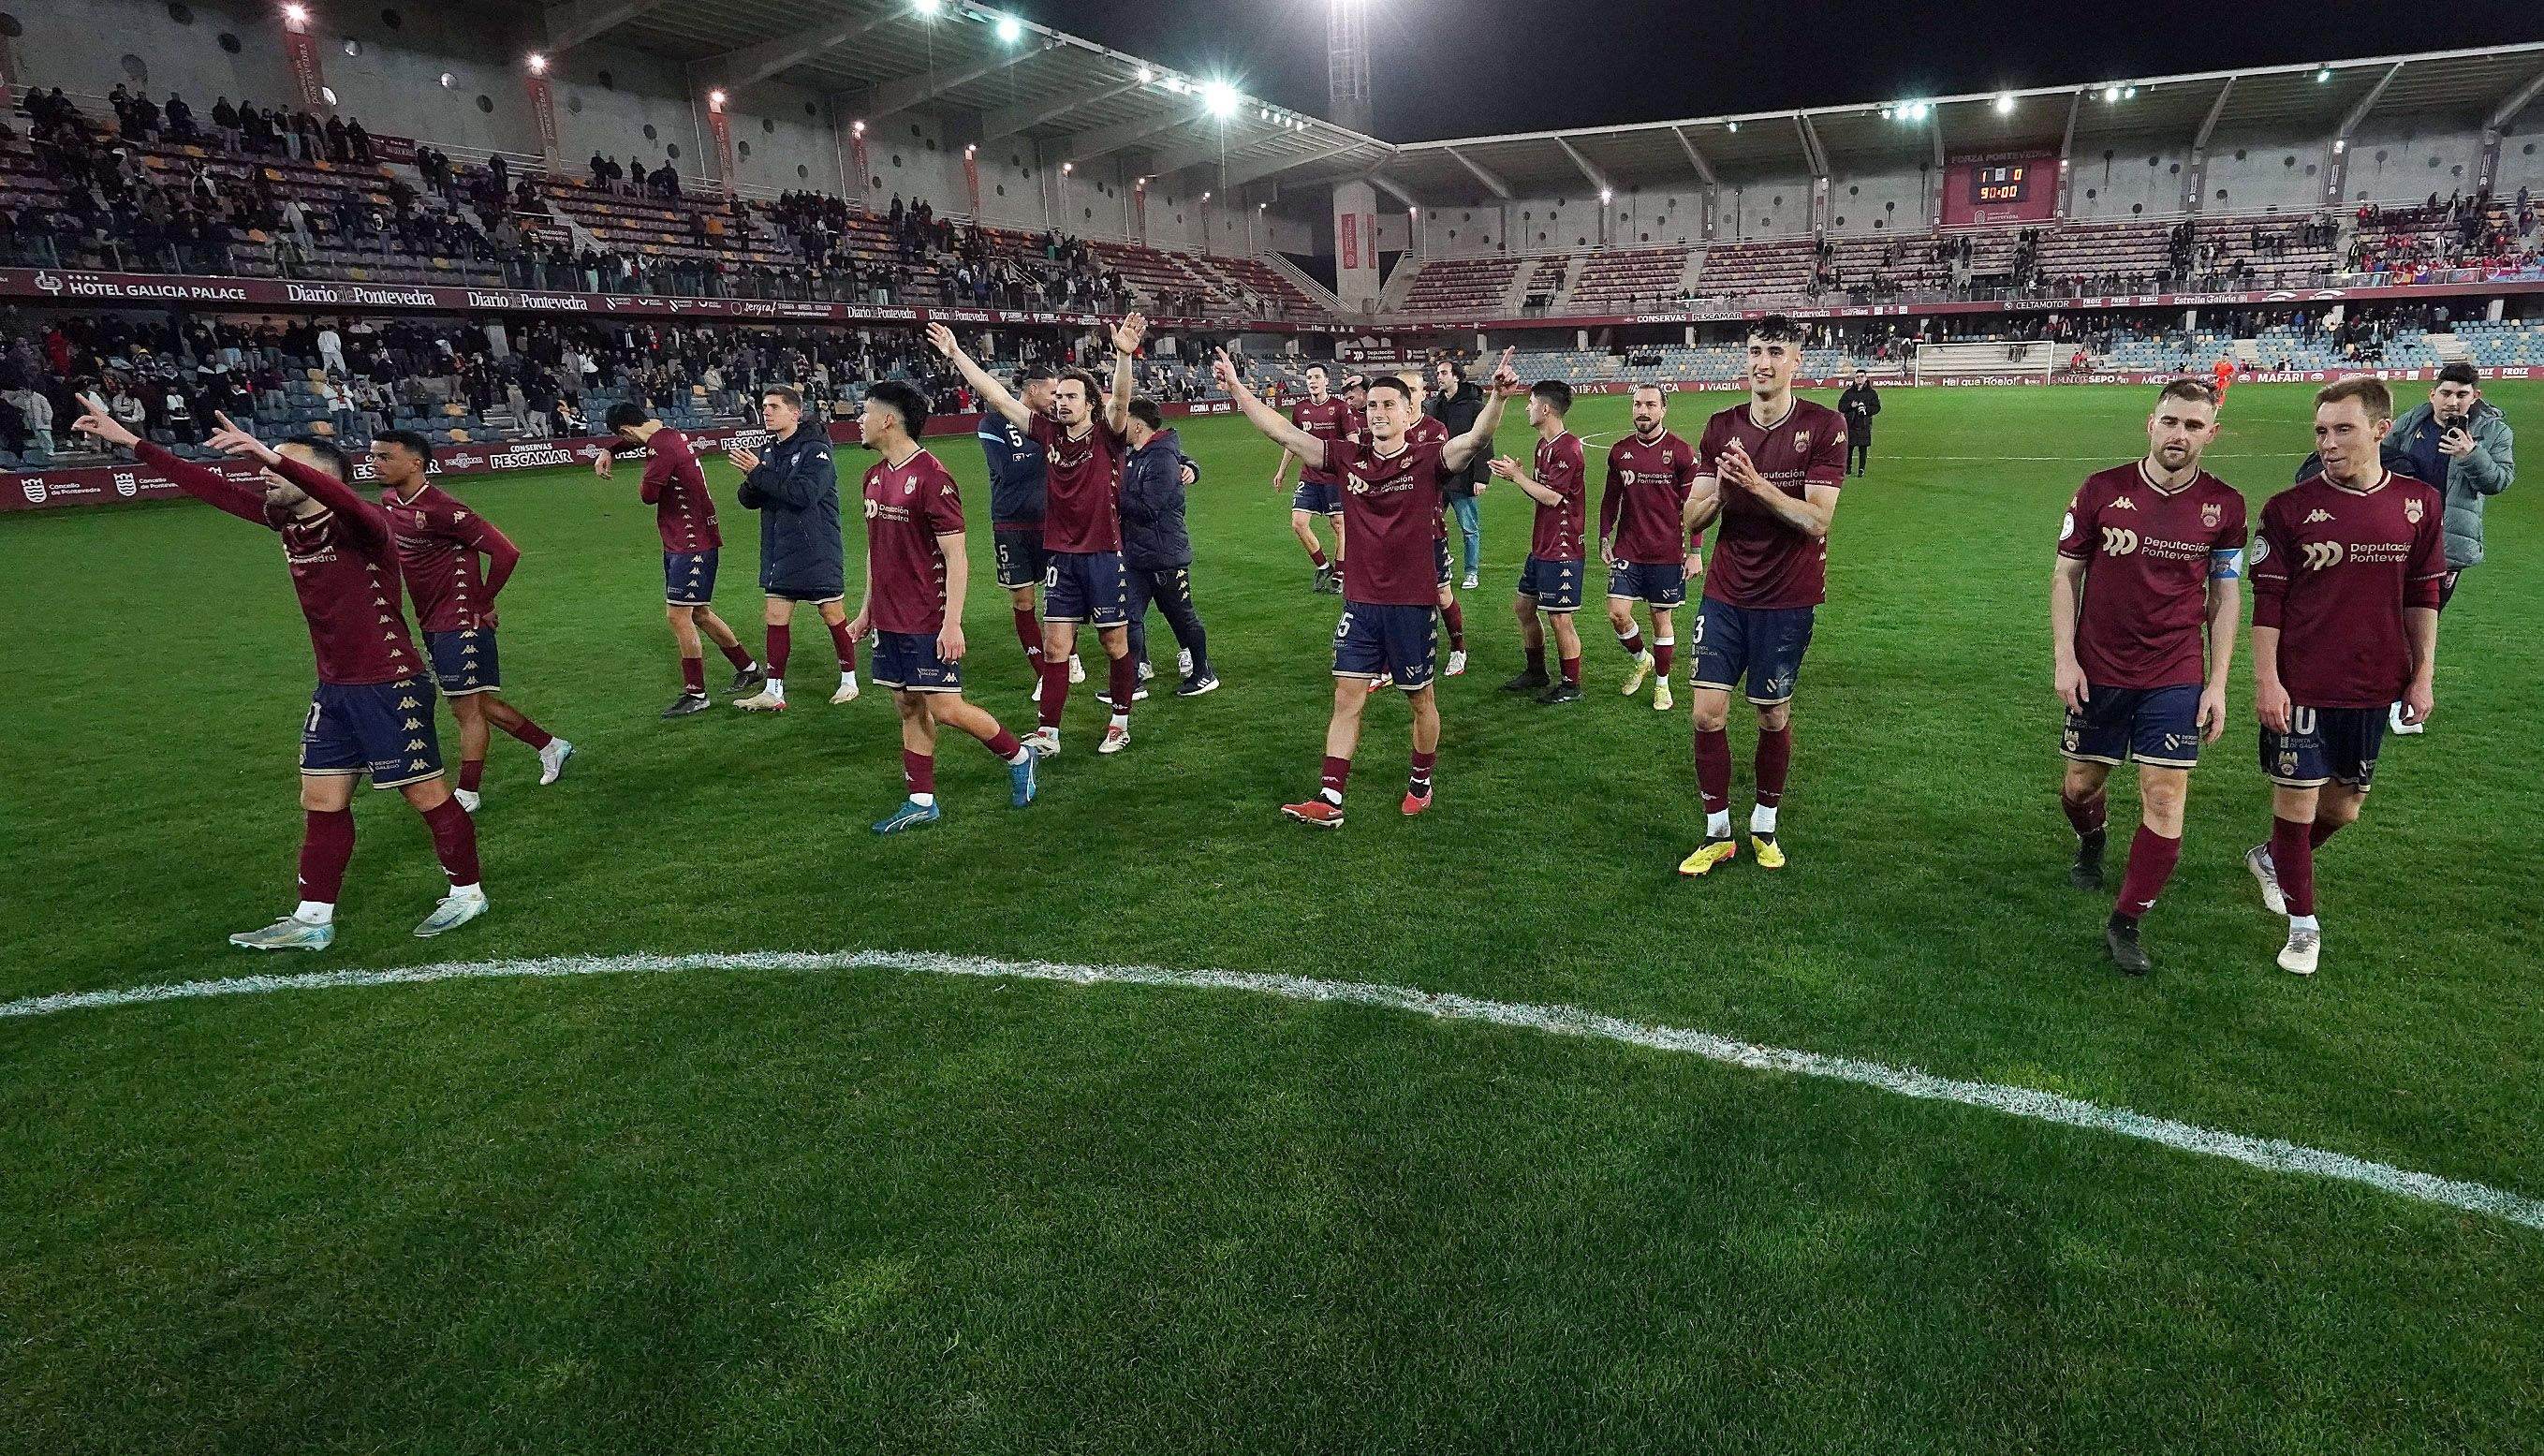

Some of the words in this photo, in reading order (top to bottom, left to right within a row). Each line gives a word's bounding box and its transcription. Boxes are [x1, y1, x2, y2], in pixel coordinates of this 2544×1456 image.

[2013, 169, 2022, 184] 0
[69, 282, 124, 296] HOTEL
[125, 285, 189, 298] GALICIA
[191, 287, 246, 300] PALACE
[286, 284, 338, 302] Diario
[354, 287, 436, 306] Pontevedra
[466, 291, 508, 308] Diario
[521, 294, 588, 311] Pontevedra
[2172, 296, 2206, 305] Estrella
[2206, 294, 2236, 303] Galicia
[2016, 301, 2069, 310] CELTAMOTOR
[847, 306, 871, 319] Diario
[876, 307, 917, 320] Pontevedra
[928, 308, 949, 321] Diario
[954, 310, 989, 322] Pontevedra
[1637, 314, 1687, 323] CONSERVAS
[1692, 311, 1743, 322] PESCAMAR
[1792, 309, 1831, 318] Pontevedra
[2502, 367, 2530, 375] FROIZ
[1962, 378, 1980, 388] que
[2088, 375, 2115, 384] SEPO
[2257, 373, 2304, 382] MAFARI
[1570, 385, 1609, 393] NIFAX
[735, 428, 767, 437] CONSERVAS
[720, 434, 778, 450] PESCAMA
[1008, 430, 1023, 448] 5
[509, 442, 553, 453] CONSERVAS
[490, 449, 575, 471] PESCAMAR
[1759, 469, 1806, 478] putación
[62, 486, 101, 494] Pontevedra
[2144, 536, 2211, 552] Deputación
[999, 545, 1009, 563] 5
[2349, 553, 2408, 563] Pontevedr
[1692, 614, 1705, 644] 3
